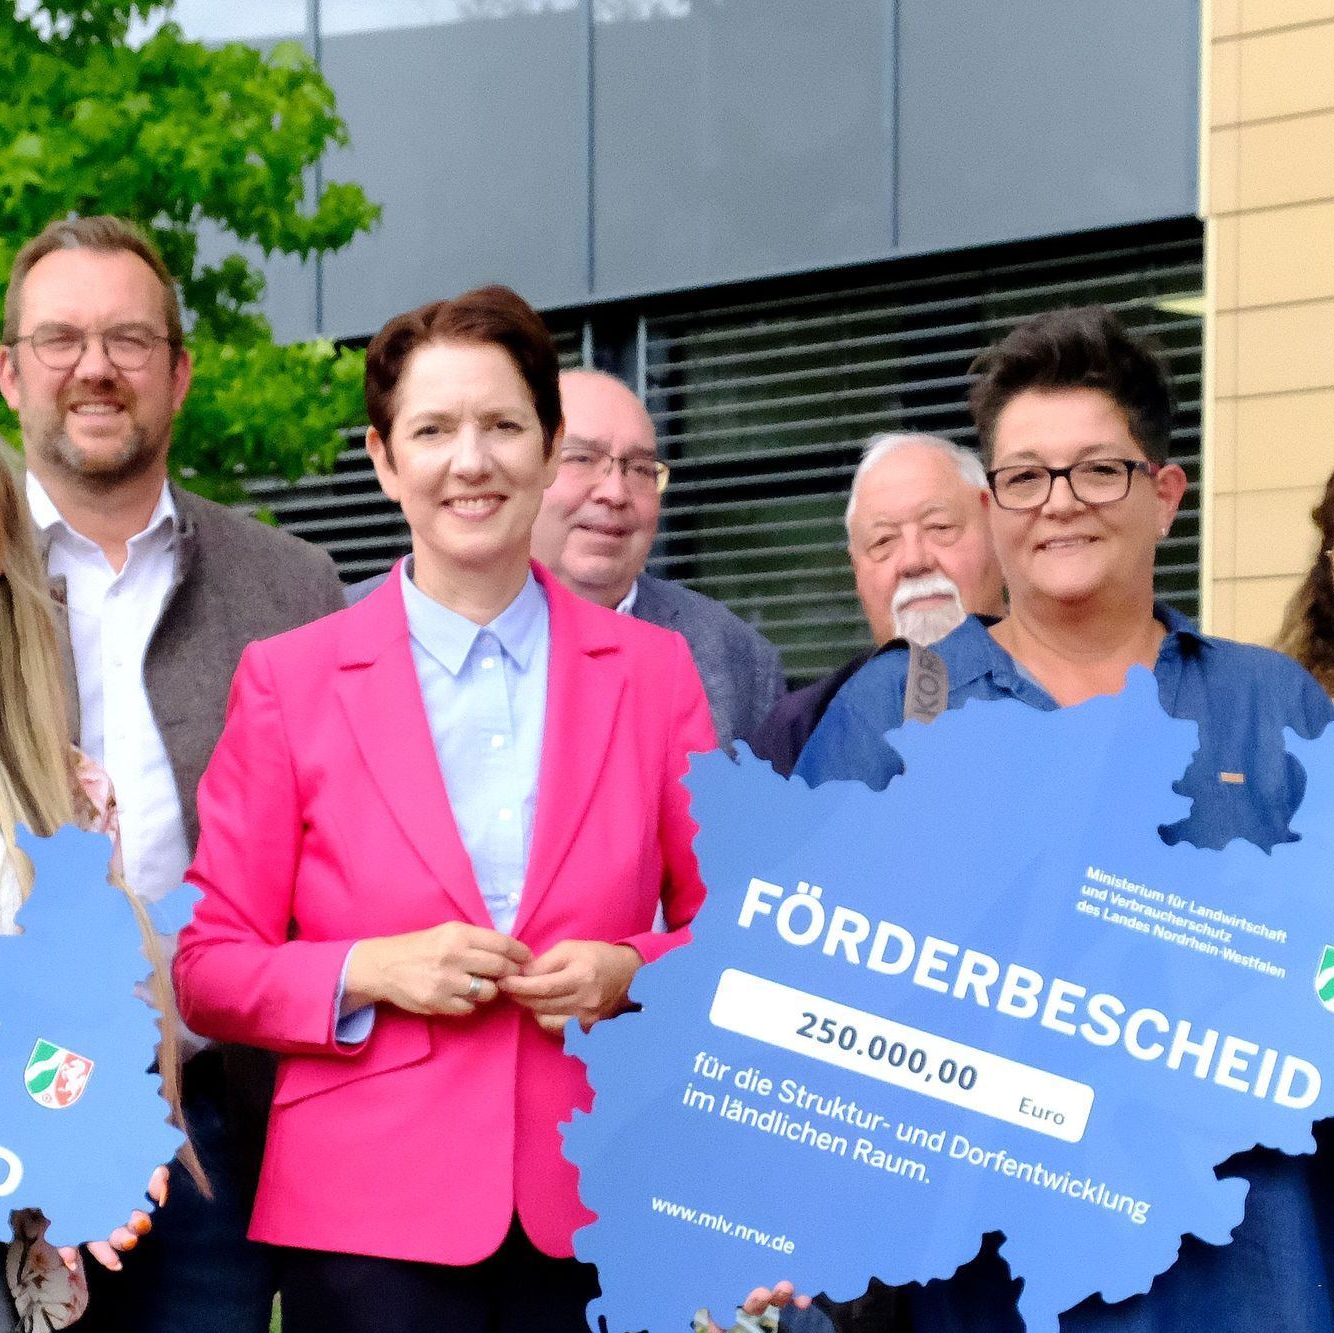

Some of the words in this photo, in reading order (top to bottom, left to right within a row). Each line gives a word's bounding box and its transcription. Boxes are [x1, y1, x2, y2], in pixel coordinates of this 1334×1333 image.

[1077, 901, 1100, 916] des
[1103, 908, 1150, 933] Landes
[1153, 924, 1285, 977] Nordrhein-Westfalen
[1082, 886, 1108, 901] und
[1111, 892, 1232, 942] Verbraucherschutz
[1087, 867, 1164, 902] Ministerium
[1167, 894, 1187, 909] für
[1189, 901, 1287, 943] Landwirtschaft
[738, 878, 1321, 1109] FÖRDERBESCHEID
[796, 1012, 977, 1090] 250.000,00
[1019, 1097, 1065, 1125] Euro
[683, 1083, 715, 1112] im
[720, 1095, 847, 1156] ländlichen
[853, 1138, 929, 1183] Raum.
[694, 1052, 731, 1080] für
[735, 1068, 772, 1095] die
[778, 1080, 890, 1130] Struktur-
[896, 1123, 946, 1152] und
[949, 1135, 1150, 1224] Dorfentwicklung
[653, 1198, 794, 1254] www.mlv.nrw.de
